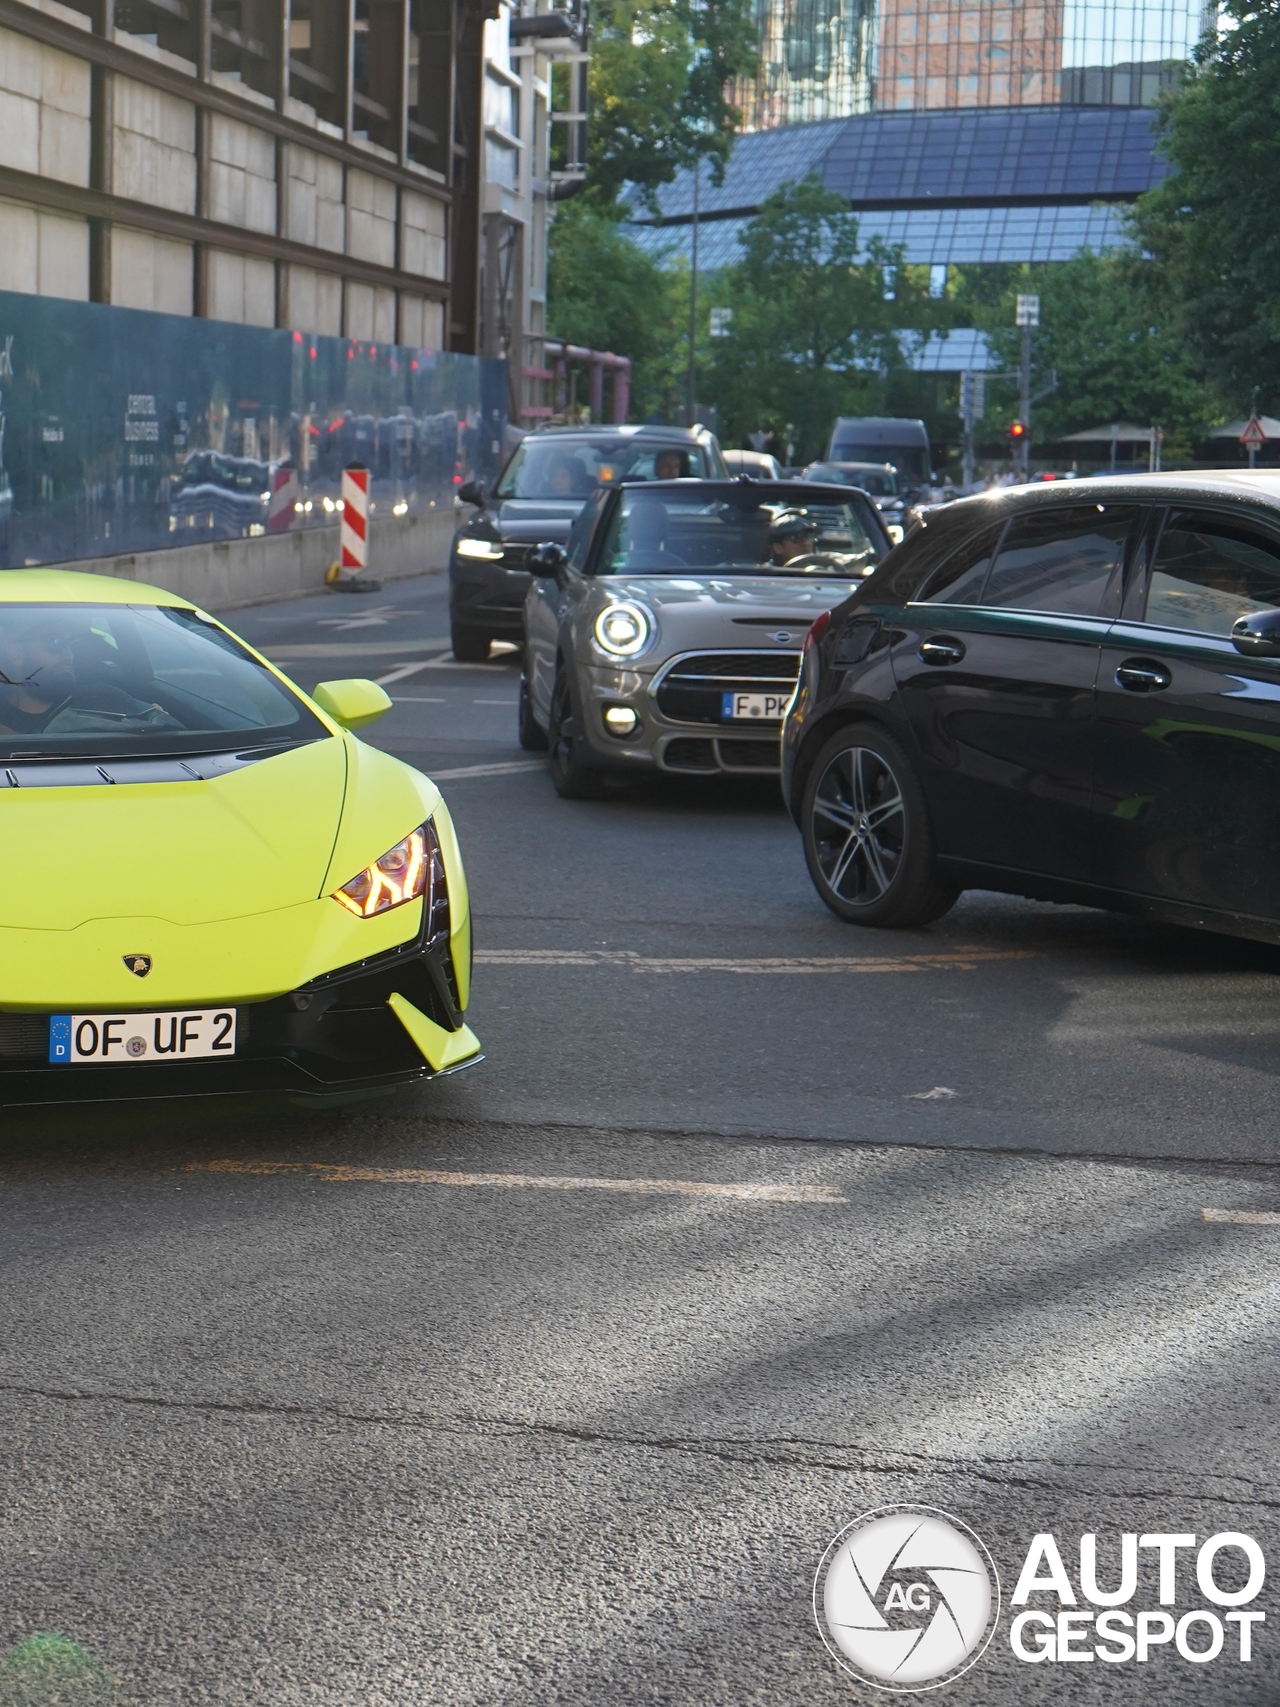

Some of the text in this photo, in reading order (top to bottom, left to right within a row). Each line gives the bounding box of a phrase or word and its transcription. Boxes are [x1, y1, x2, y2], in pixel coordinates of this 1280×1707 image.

[737, 696, 749, 715] F
[55, 1013, 233, 1057] D OF UF 2
